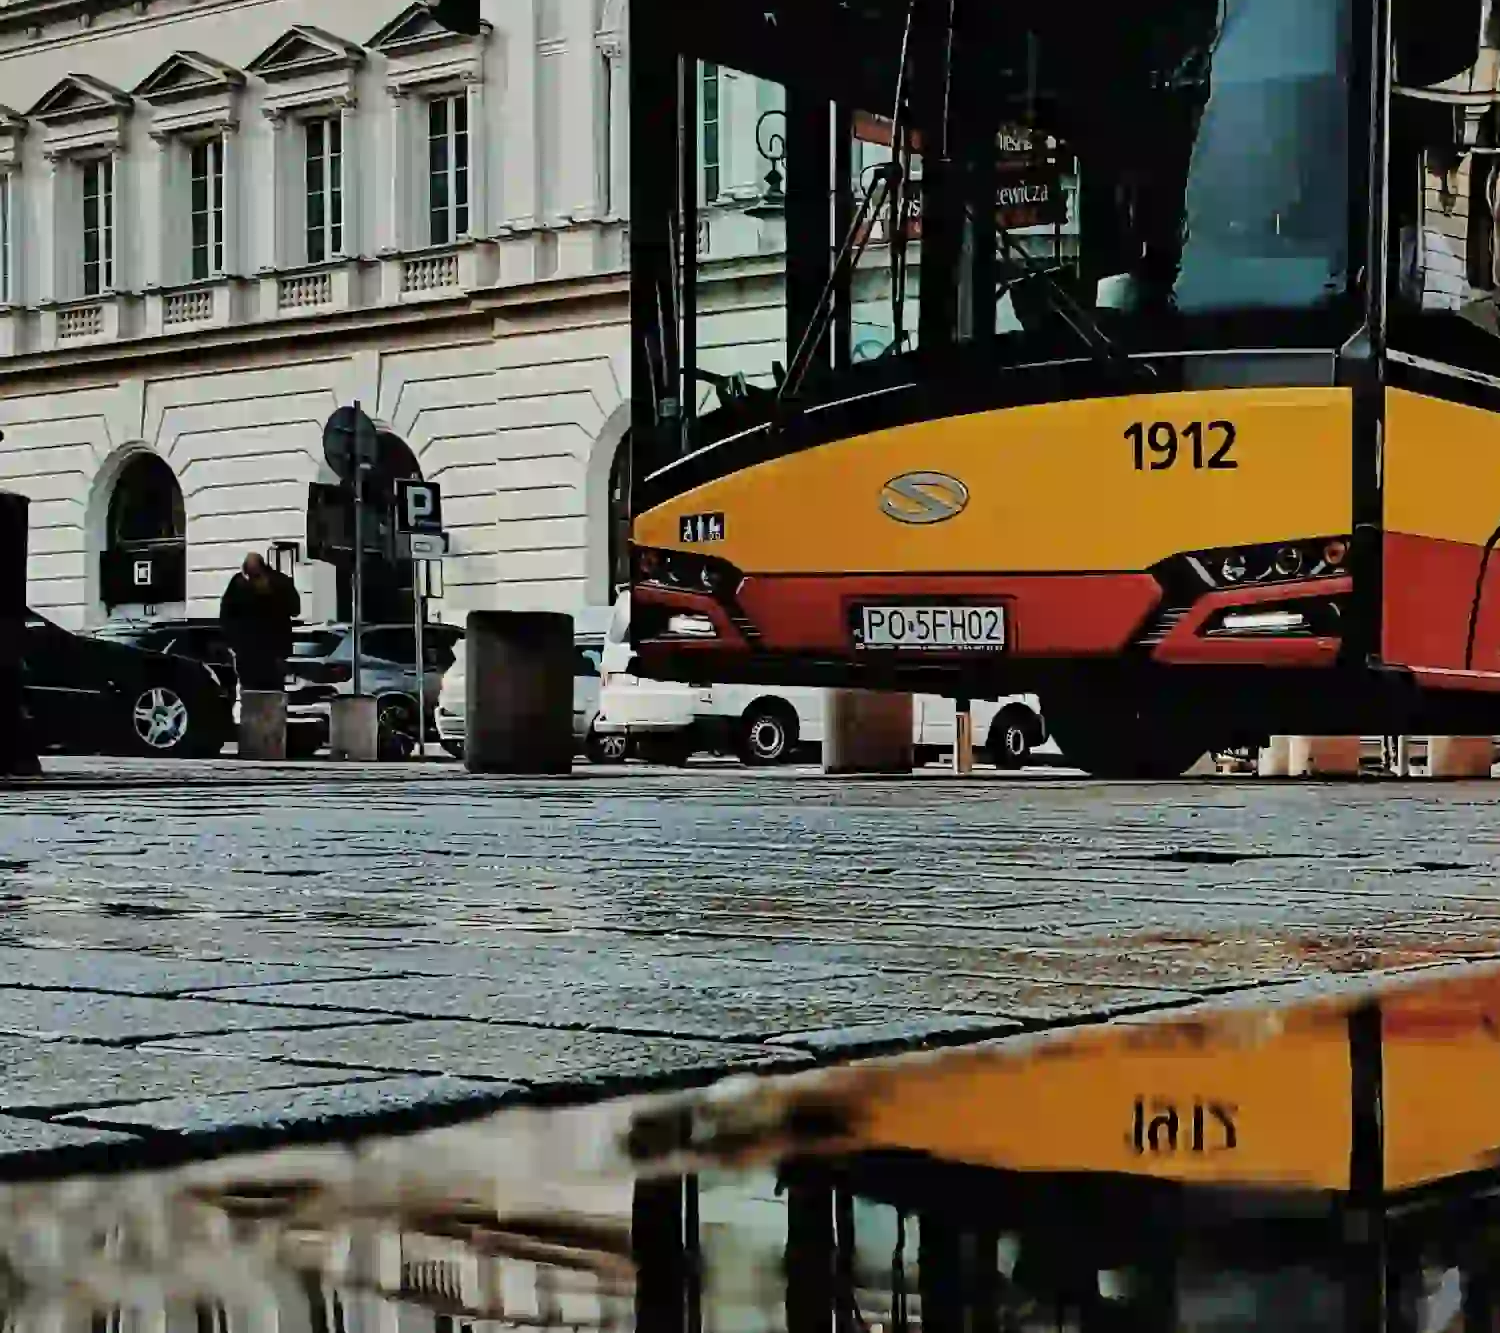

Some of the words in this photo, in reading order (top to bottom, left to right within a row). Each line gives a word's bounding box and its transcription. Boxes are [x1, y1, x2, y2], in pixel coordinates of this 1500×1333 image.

[1123, 420, 1238, 470] 1912
[407, 485, 432, 527] P
[868, 610, 905, 640] PO
[916, 609, 1001, 642] 5FH02
